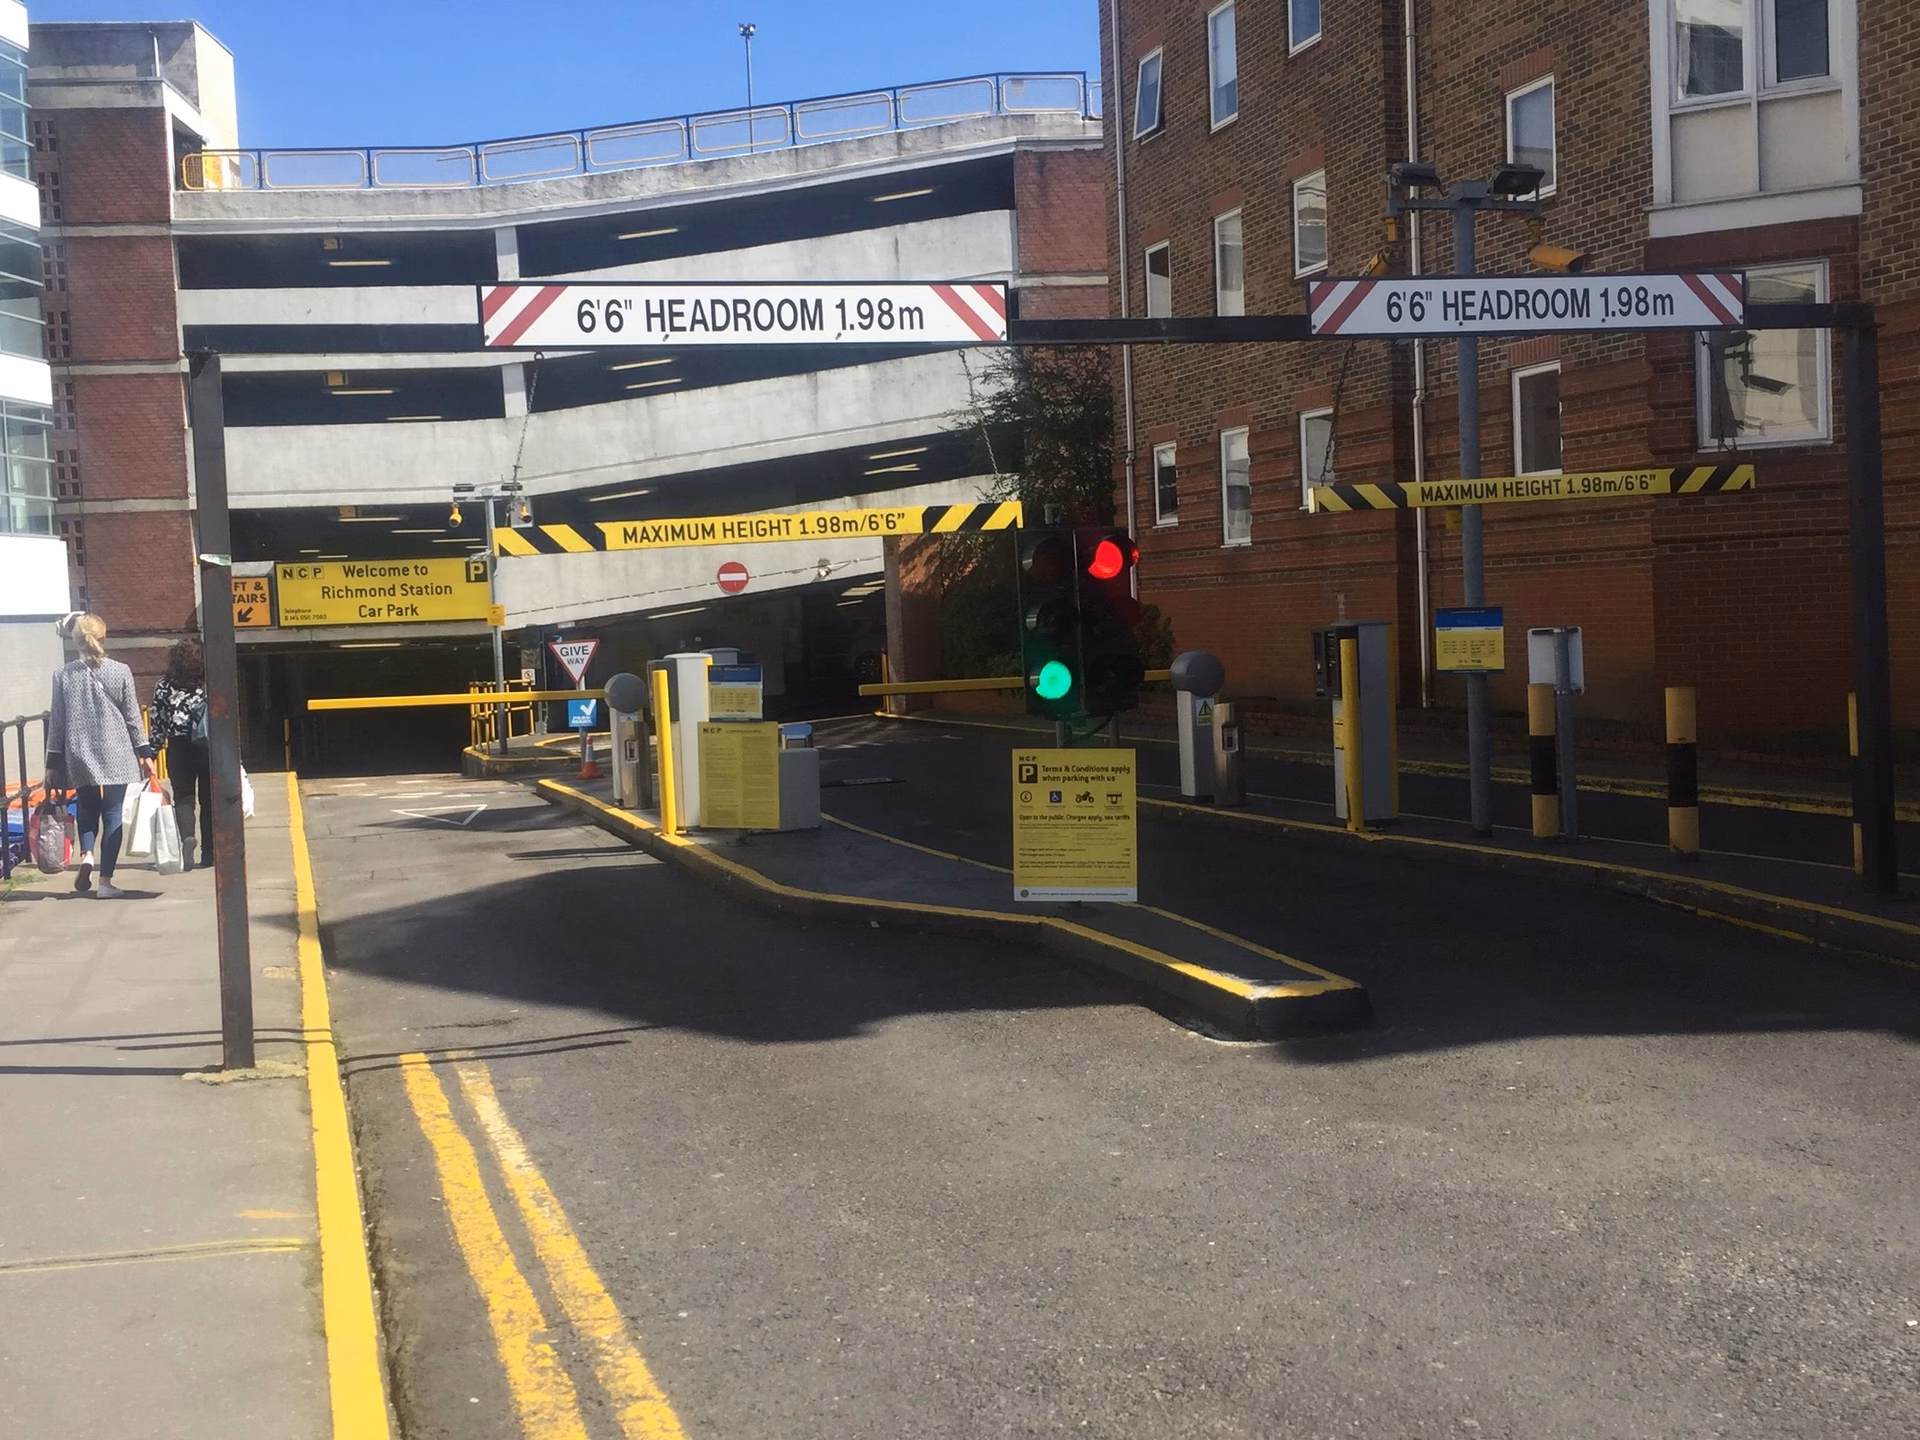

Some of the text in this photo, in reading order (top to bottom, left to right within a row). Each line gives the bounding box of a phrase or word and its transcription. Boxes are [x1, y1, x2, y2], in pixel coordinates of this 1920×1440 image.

[1386, 286, 1674, 322] 6'6" HEADROOM 1.98m
[577, 298, 924, 333] 6'6" HEADROOM 1.98m
[1420, 483, 1498, 502] MAXIMUM
[1503, 479, 1562, 498] HEIGHT
[622, 522, 716, 544] MAXIMUM
[722, 518, 792, 539] HEIGHT
[342, 564, 428, 578] Welcome to
[233, 581, 264, 591] FT &
[322, 582, 452, 599] Richmond Station
[232, 594, 267, 604] TAIRS
[358, 603, 419, 618] Car Park
[560, 645, 590, 657] GIVE
[1022, 766, 1034, 782] P
[1111, 765, 1130, 774] apply
[1062, 775, 1089, 783] parking
